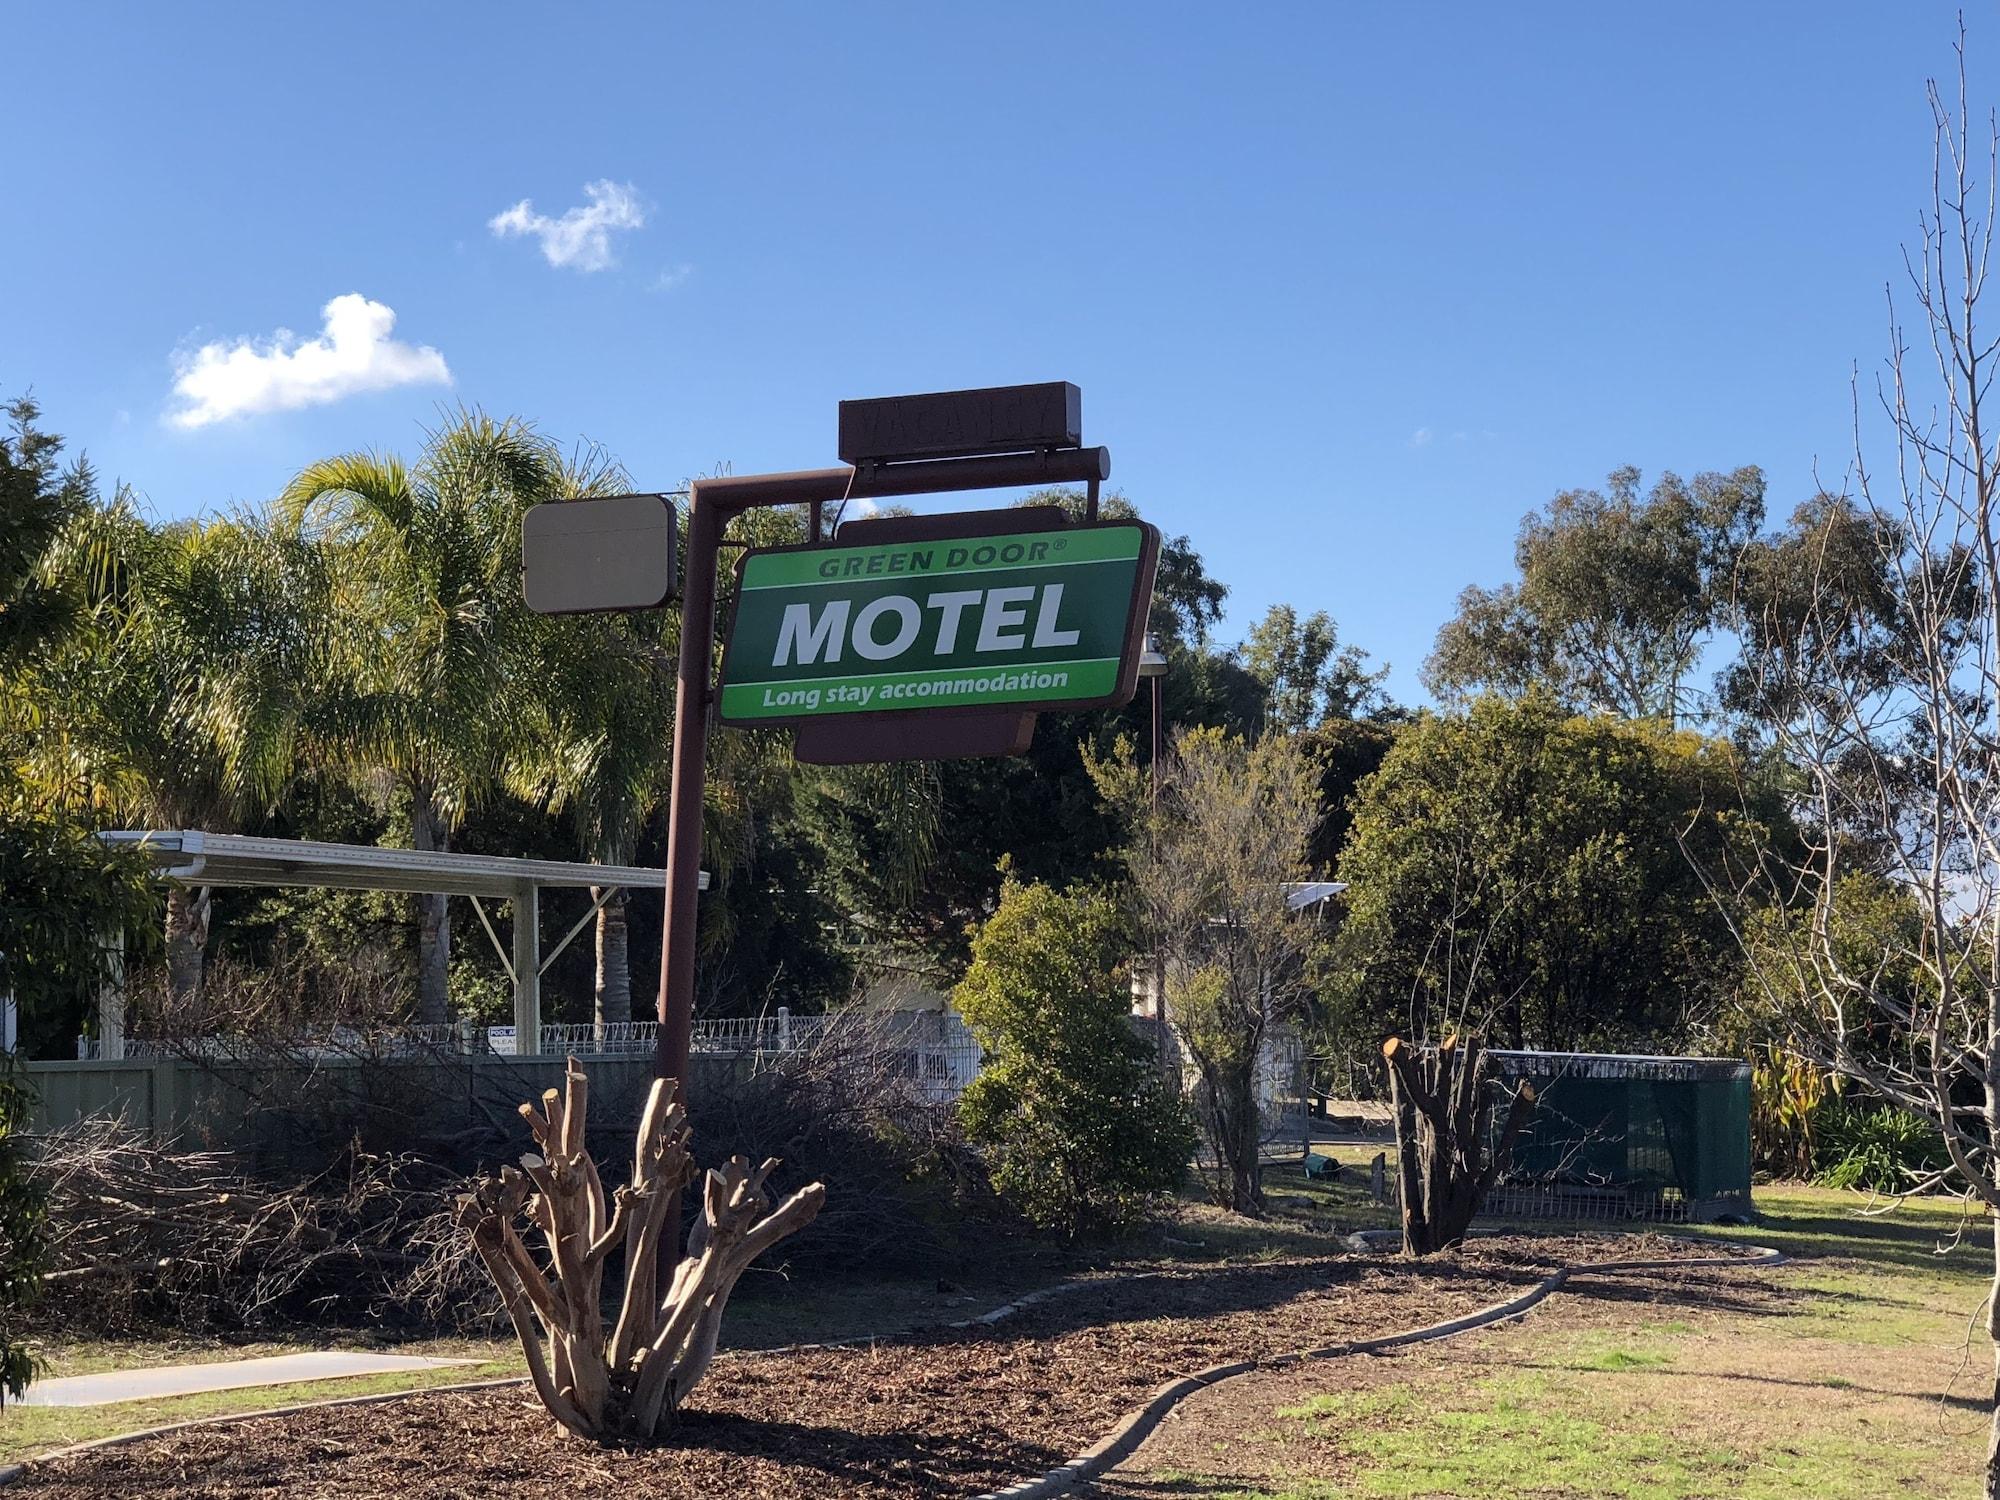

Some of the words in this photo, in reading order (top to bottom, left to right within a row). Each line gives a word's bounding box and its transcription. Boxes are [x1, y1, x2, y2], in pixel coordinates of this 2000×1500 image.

[818, 550, 934, 578] GREEN
[772, 583, 1081, 667] MOTEL
[762, 688, 821, 710] Long
[826, 684, 875, 706] stay
[879, 670, 1068, 700] accommodation
